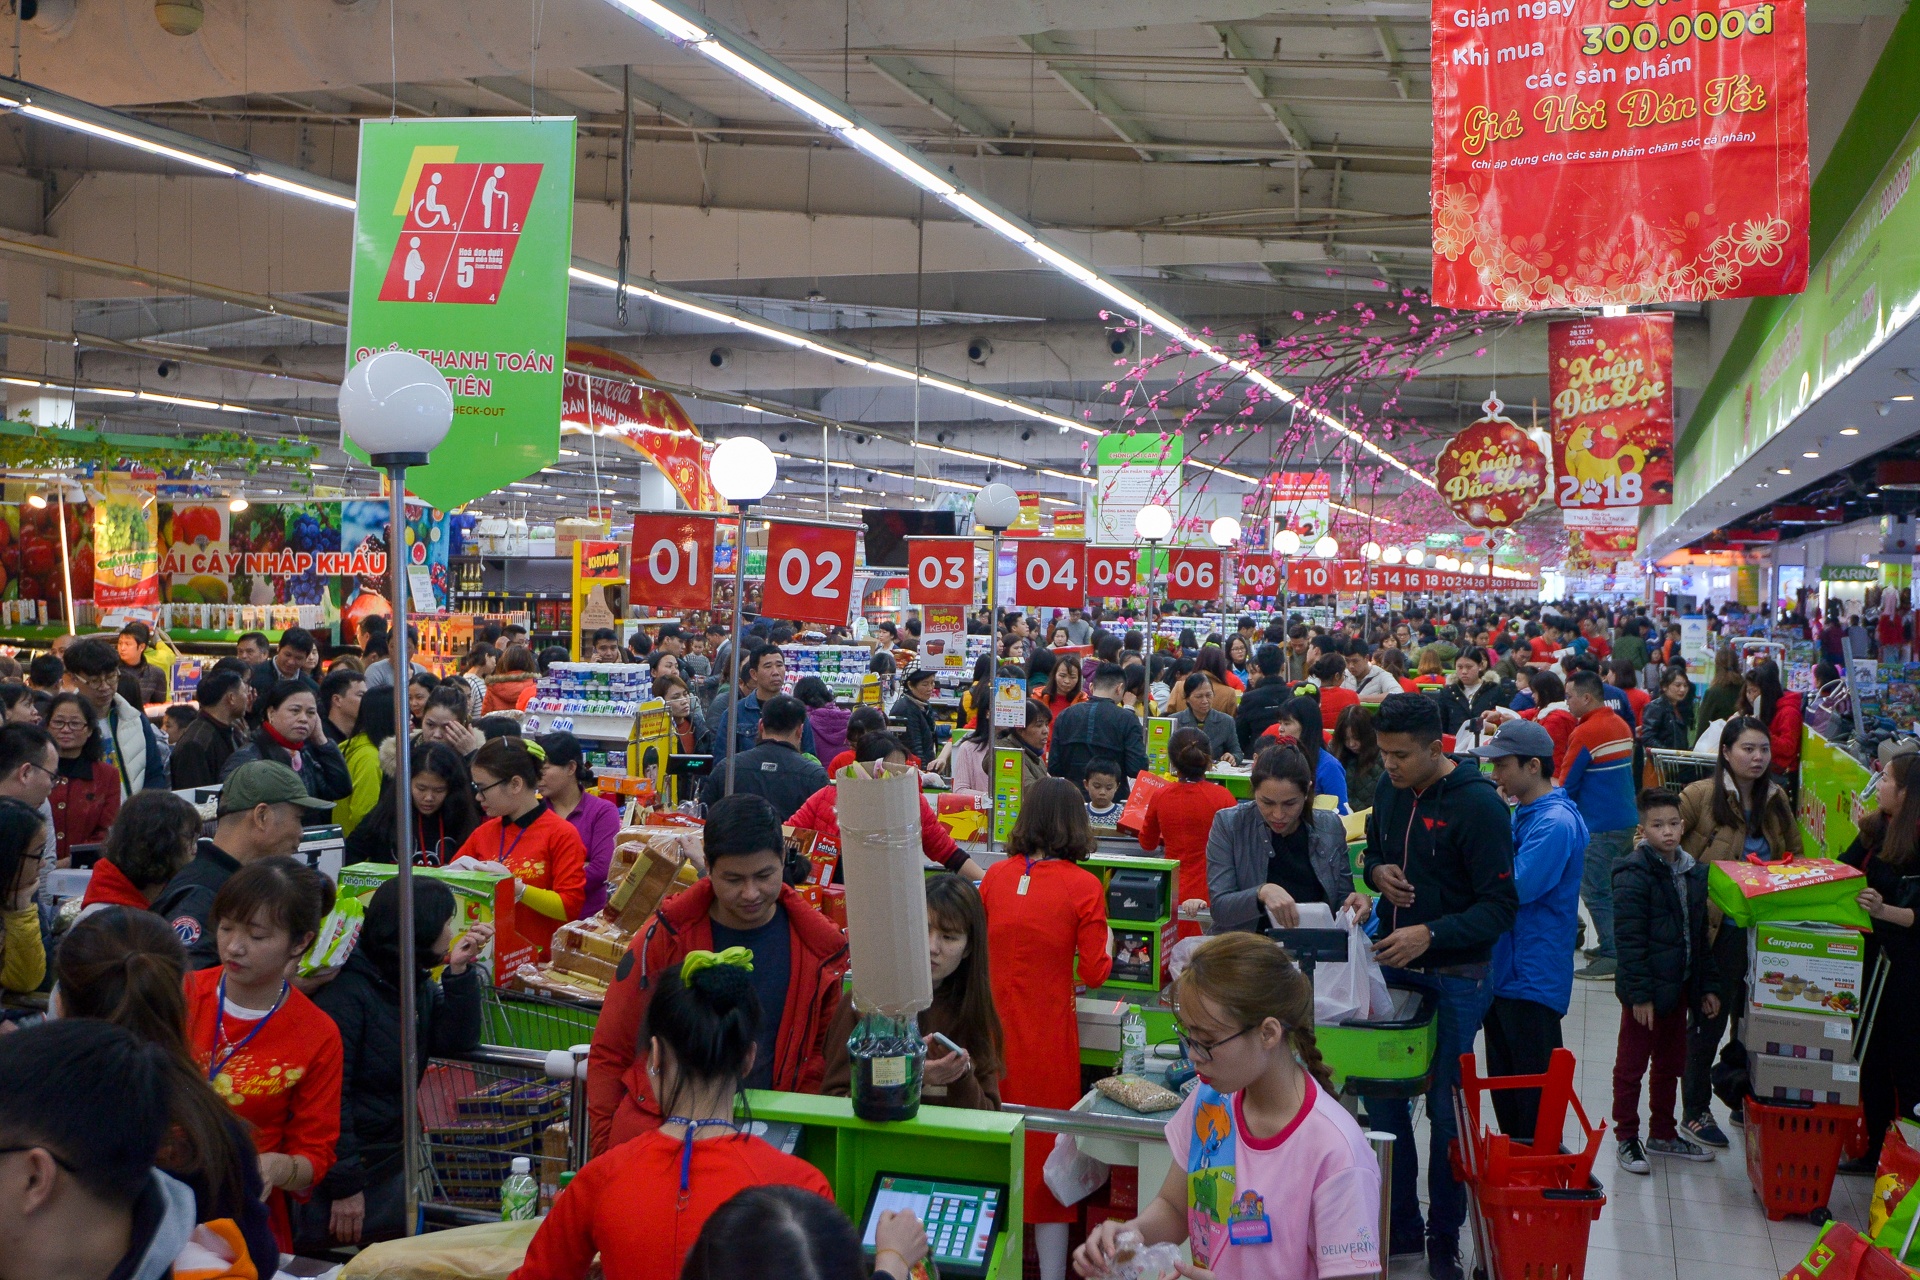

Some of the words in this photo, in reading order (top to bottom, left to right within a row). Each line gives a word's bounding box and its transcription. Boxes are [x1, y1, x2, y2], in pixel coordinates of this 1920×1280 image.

[1453, 6, 1510, 28] Giảm
[1453, 48, 1489, 66] Khi
[1497, 41, 1545, 63] mua
[1582, 4, 1775, 56] 300.000đ
[1525, 68, 1567, 90] các
[1574, 63, 1616, 85] sản
[1625, 53, 1691, 85] phẩm
[1461, 105, 1524, 156] Giá
[1533, 94, 1607, 133] Hời
[1617, 88, 1697, 128] Đón
[1703, 75, 1767, 116] Tết
[1493, 159, 1508, 170] áp
[1510, 155, 1539, 167] dụng
[1542, 151, 1563, 162] cho
[1566, 149, 1587, 160] các
[1681, 136, 1700, 149] sóc
[1721, 132, 1756, 143] nhân)
[512, 222, 519, 231] 2
[457, 256, 475, 288] 5
[489, 294, 496, 302] 4
[418, 350, 489, 370] THANH
[494, 350, 554, 373] TOÁN
[1568, 354, 1645, 389] Xuân
[562, 396, 585, 416] RÀN
[1553, 384, 1611, 420] Đắc
[1610, 374, 1665, 409] Lộc
[453, 405, 506, 417] HECK-OUT
[1459, 448, 1523, 477] Xuân
[1443, 473, 1494, 501] Đắc
[1493, 467, 1540, 496] Lộc
[158, 547, 186, 575] ÁI
[191, 548, 241, 575] CÂY
[244, 552, 313, 579] NHẬP
[316, 545, 387, 577] KHẨU
[648, 538, 698, 586] 01
[778, 547, 842, 600] 02
[917, 556, 965, 589] 03
[1025, 557, 1078, 591] 04
[1093, 559, 1131, 586] 05
[1175, 561, 1214, 588] 06
[1243, 564, 1276, 586] 08
[1828, 568, 1880, 580] KARINA
[1304, 567, 1328, 587] 10
[1343, 569, 1362, 586] 12
[1383, 571, 1401, 585] 14
[1404, 573, 1420, 586] 16
[1425, 574, 1439, 586] 18
[343, 876, 365, 887] Nhận
[1764, 935, 1814, 950] Kangaroo
